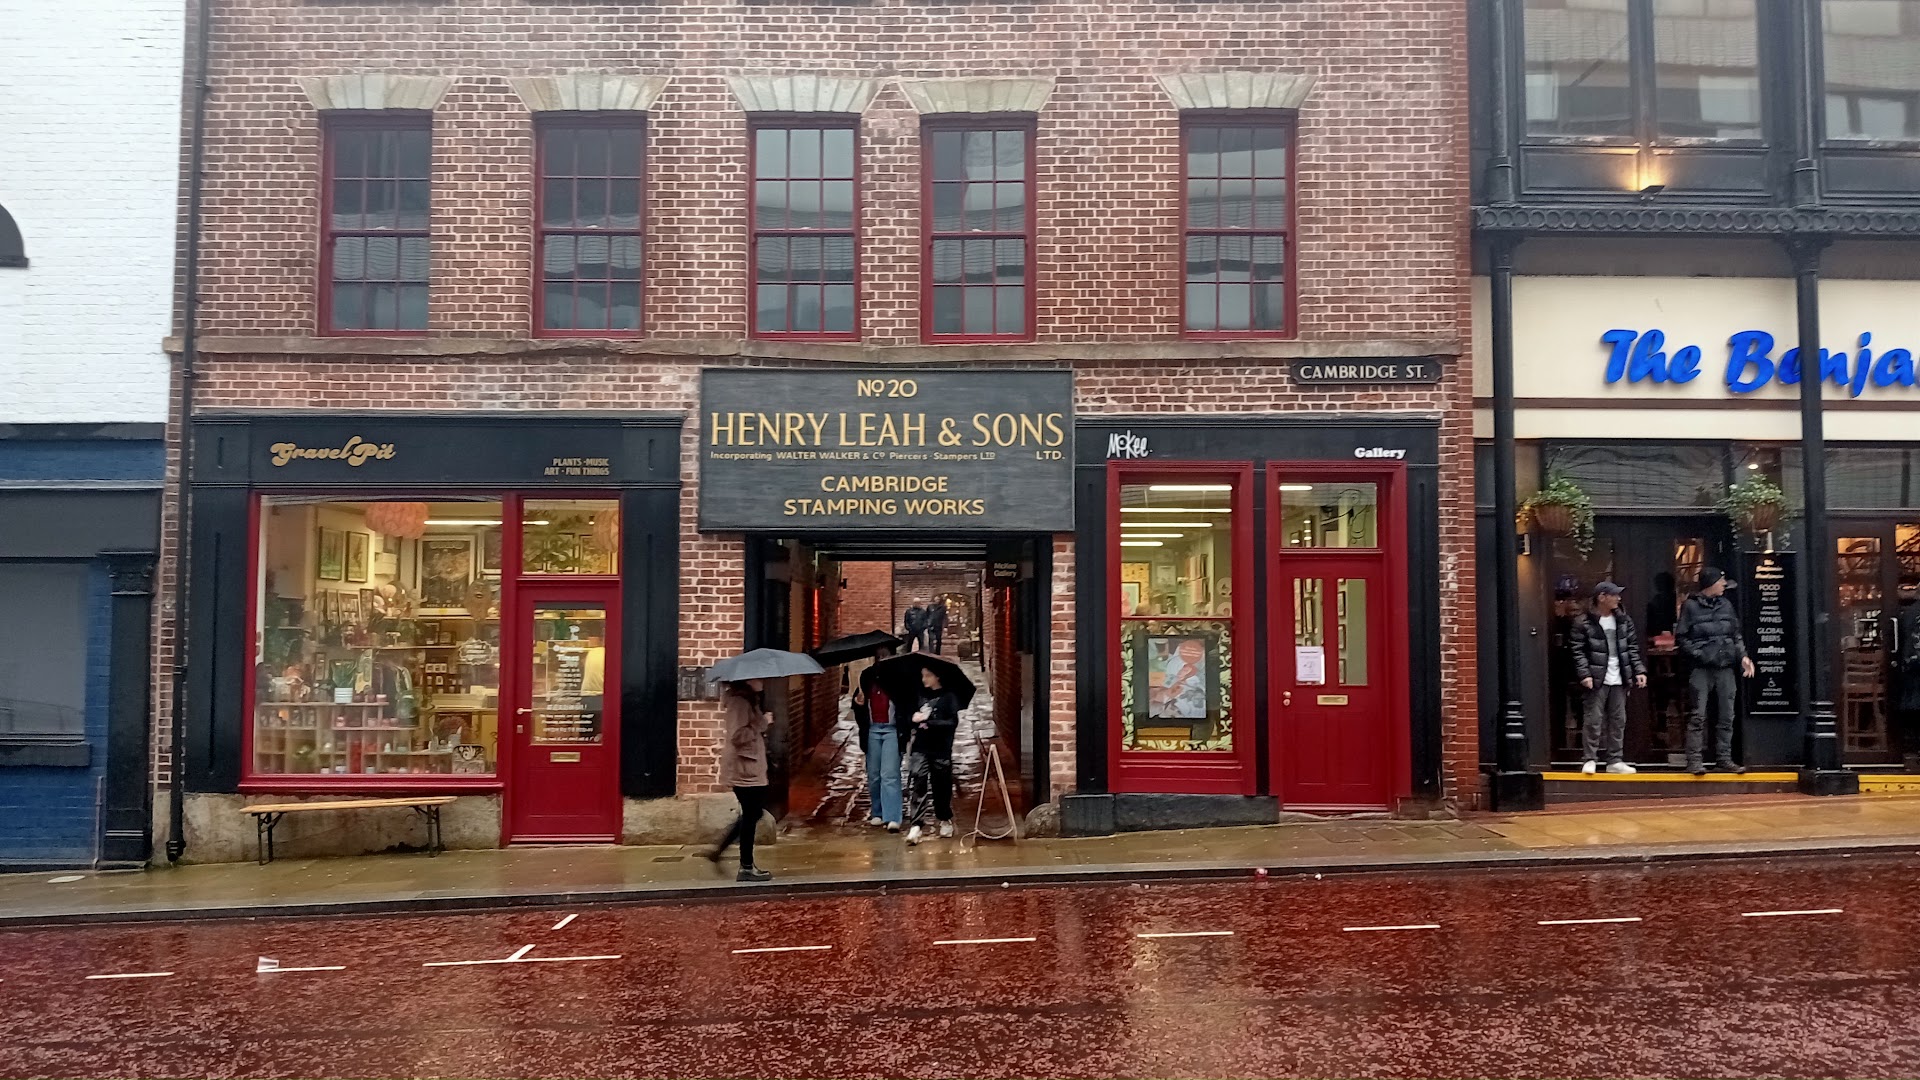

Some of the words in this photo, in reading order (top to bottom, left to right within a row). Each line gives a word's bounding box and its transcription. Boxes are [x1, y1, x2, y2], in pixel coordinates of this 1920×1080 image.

[1602, 329, 1702, 384] The
[1300, 365, 1398, 380] CAMBRIDGE
[1406, 365, 1428, 379] ST.
[710, 412, 829, 447] HENRY
[838, 413, 926, 446] LEAH
[937, 417, 962, 447] &
[972, 412, 1064, 447] SONS
[270, 435, 362, 466] Gravel
[348, 443, 396, 466] Pit
[710, 451, 772, 461] Incorporating
[776, 451, 816, 460] WALTER
[819, 451, 860, 460] WALKER
[862, 451, 869, 460] &
[889, 452, 927, 460] Piercers
[933, 452, 978, 462] Stampers
[1036, 450, 1065, 461] LTD.
[1354, 448, 1406, 460] Gallery
[552, 458, 582, 466] PLANTS
[544, 467, 560, 475] ART
[565, 467, 581, 475] FUN
[582, 467, 610, 475] THINGS
[820, 476, 948, 493] CAMBRIDGE
[783, 499, 897, 516] STAMPING
[905, 499, 985, 516] WORKS
[993, 570, 1017, 578] Gallery
